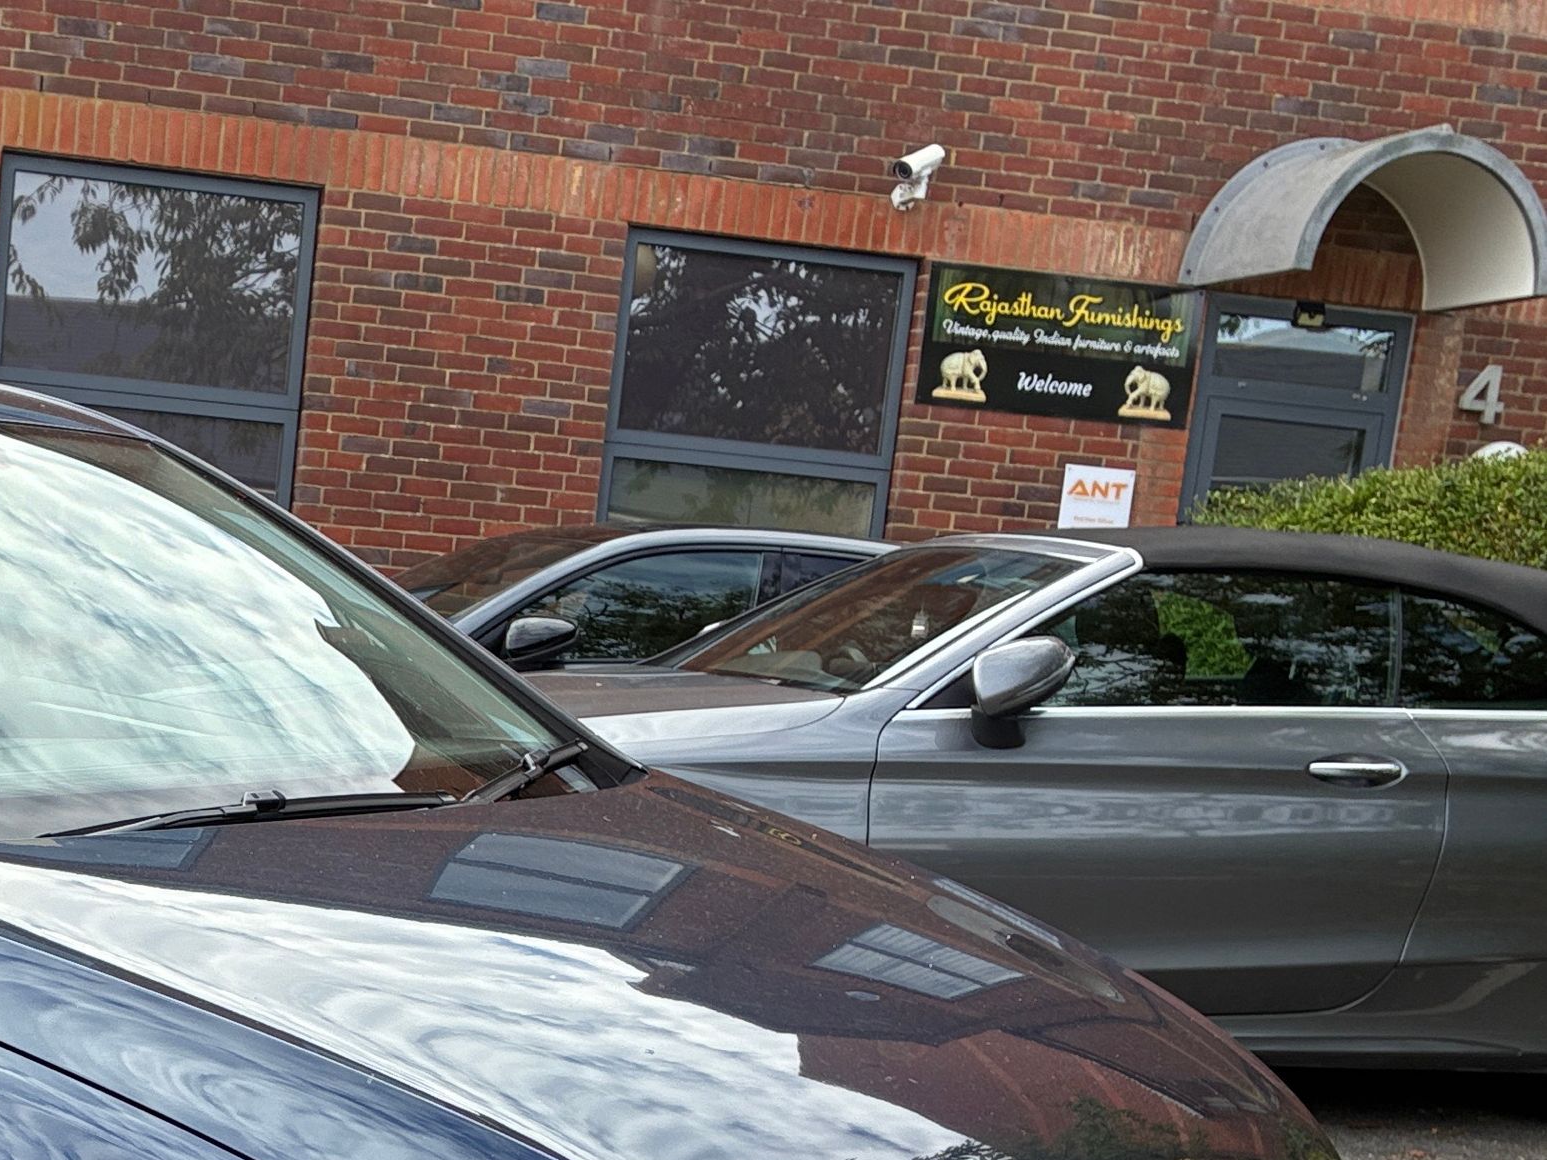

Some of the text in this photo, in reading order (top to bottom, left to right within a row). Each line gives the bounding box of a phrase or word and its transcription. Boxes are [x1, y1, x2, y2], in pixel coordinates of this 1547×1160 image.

[944, 282, 1185, 343] Rajasthan Furnishings
[1033, 328, 1072, 347] Indian
[1072, 334, 1121, 351] furniture
[1123, 340, 1133, 354] &
[1017, 371, 1093, 398] Welcome
[1458, 363, 1505, 425] 4
[1066, 478, 1129, 501] ANT
